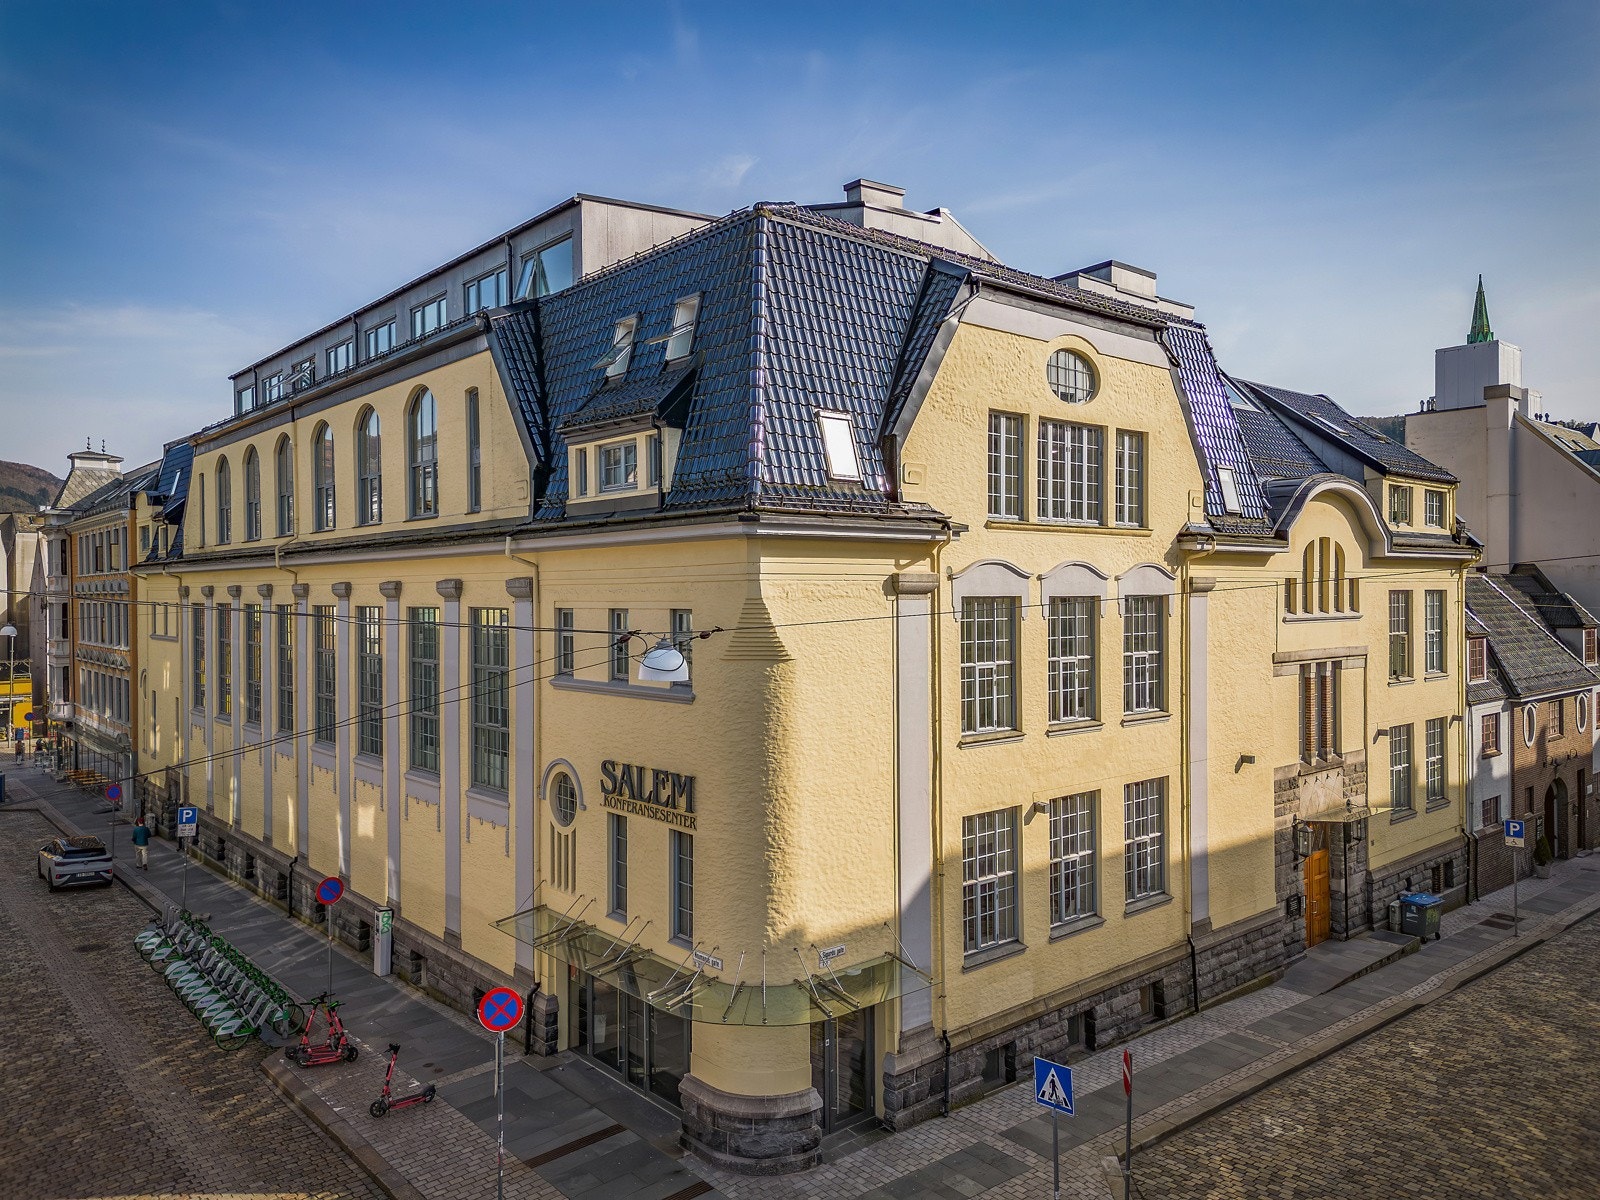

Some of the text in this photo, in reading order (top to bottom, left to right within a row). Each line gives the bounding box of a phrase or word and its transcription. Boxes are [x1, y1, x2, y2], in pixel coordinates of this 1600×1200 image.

[600, 760, 696, 813] SALEM
[182, 810, 193, 823] P
[603, 795, 697, 831] KONFERANSESENTER
[1510, 822, 1520, 836] P
